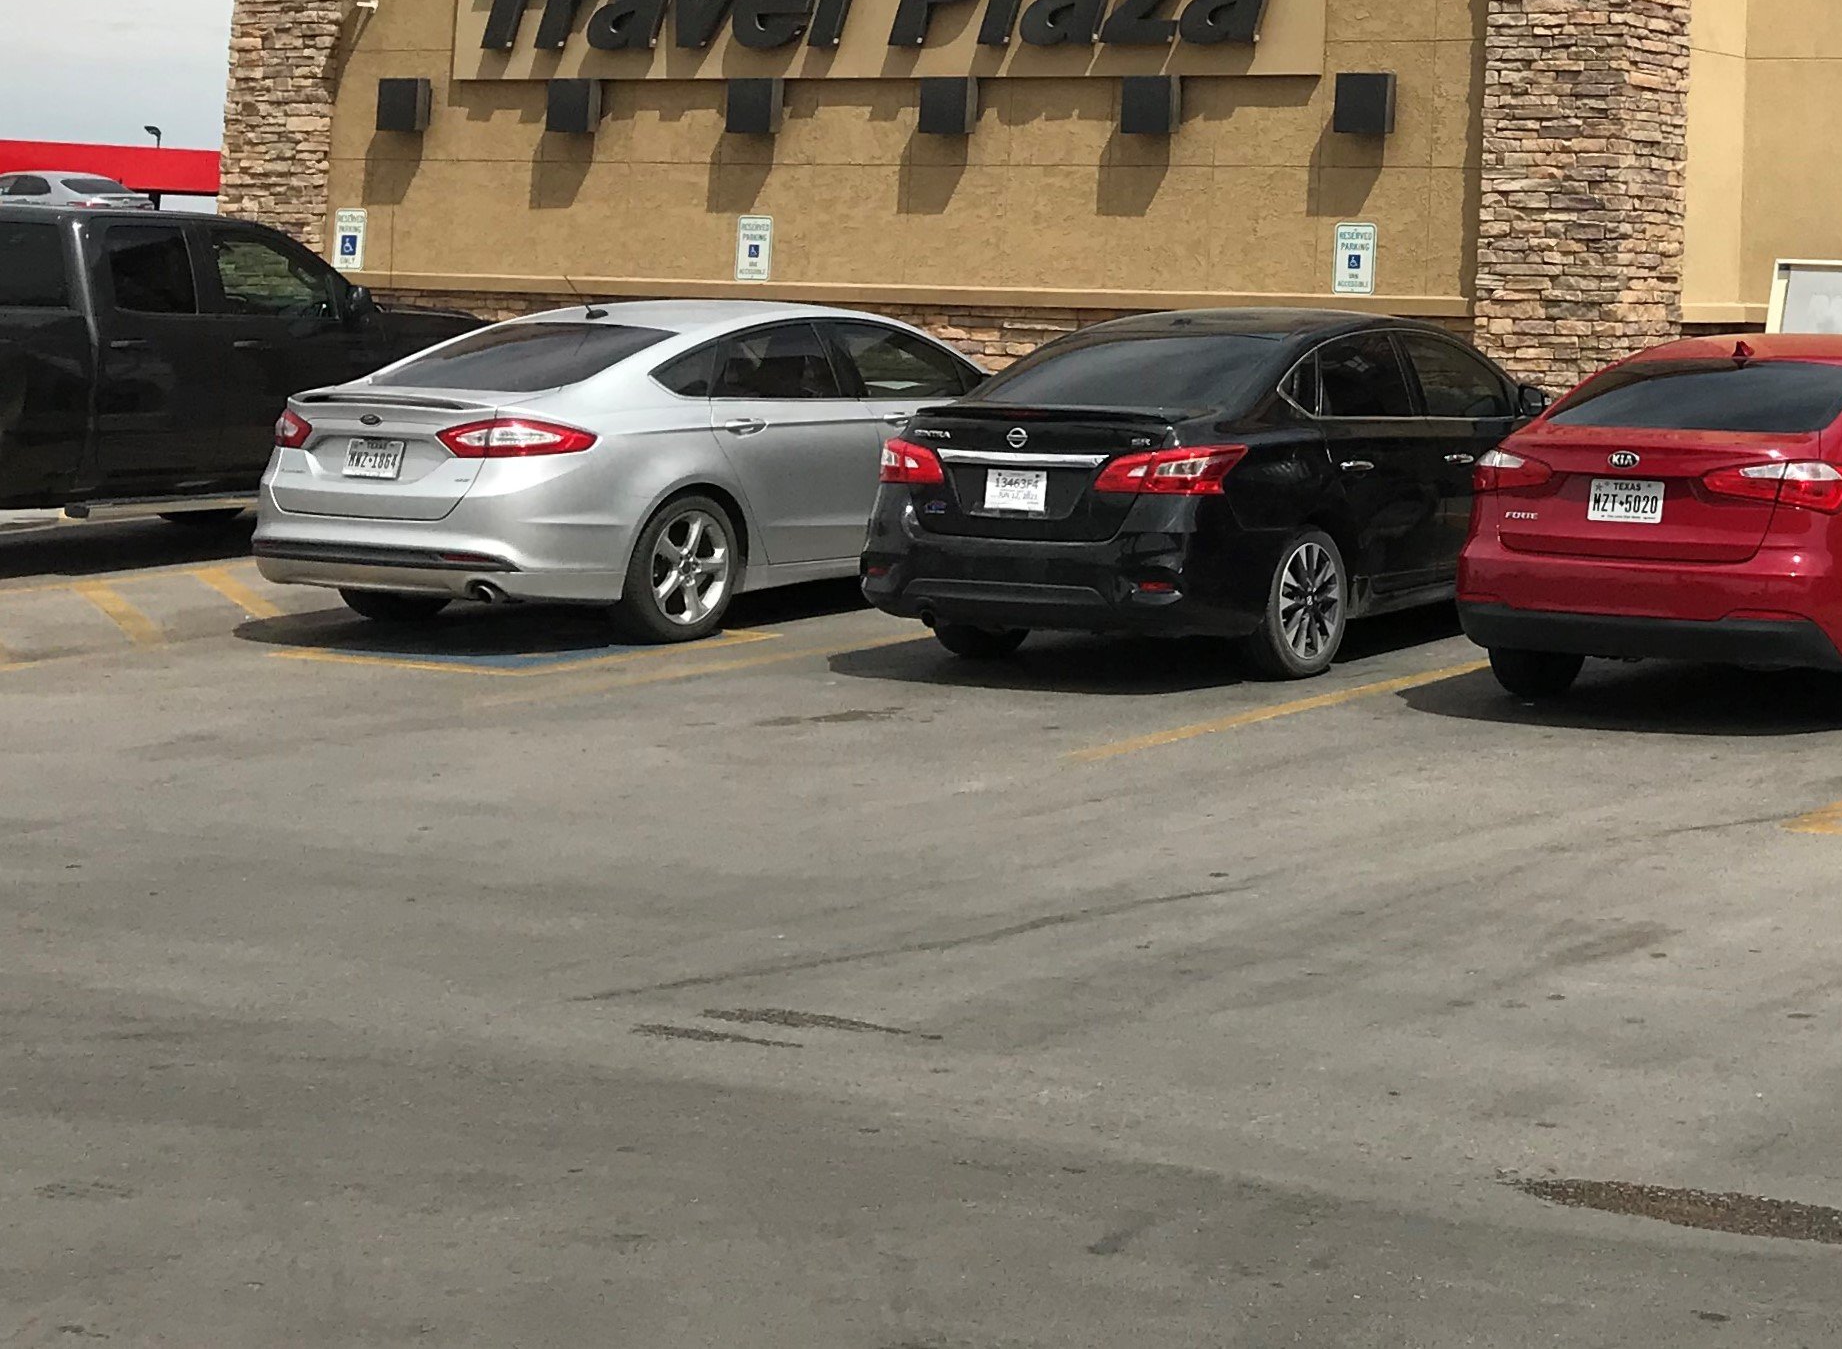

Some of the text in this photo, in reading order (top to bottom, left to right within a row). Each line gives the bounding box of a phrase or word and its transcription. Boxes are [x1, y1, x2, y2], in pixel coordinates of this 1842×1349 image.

[1339, 231, 1373, 241] RESERVED
[1340, 241, 1370, 251] PARKING
[1611, 453, 1635, 466] KIA
[1613, 481, 1642, 492] TEXAS
